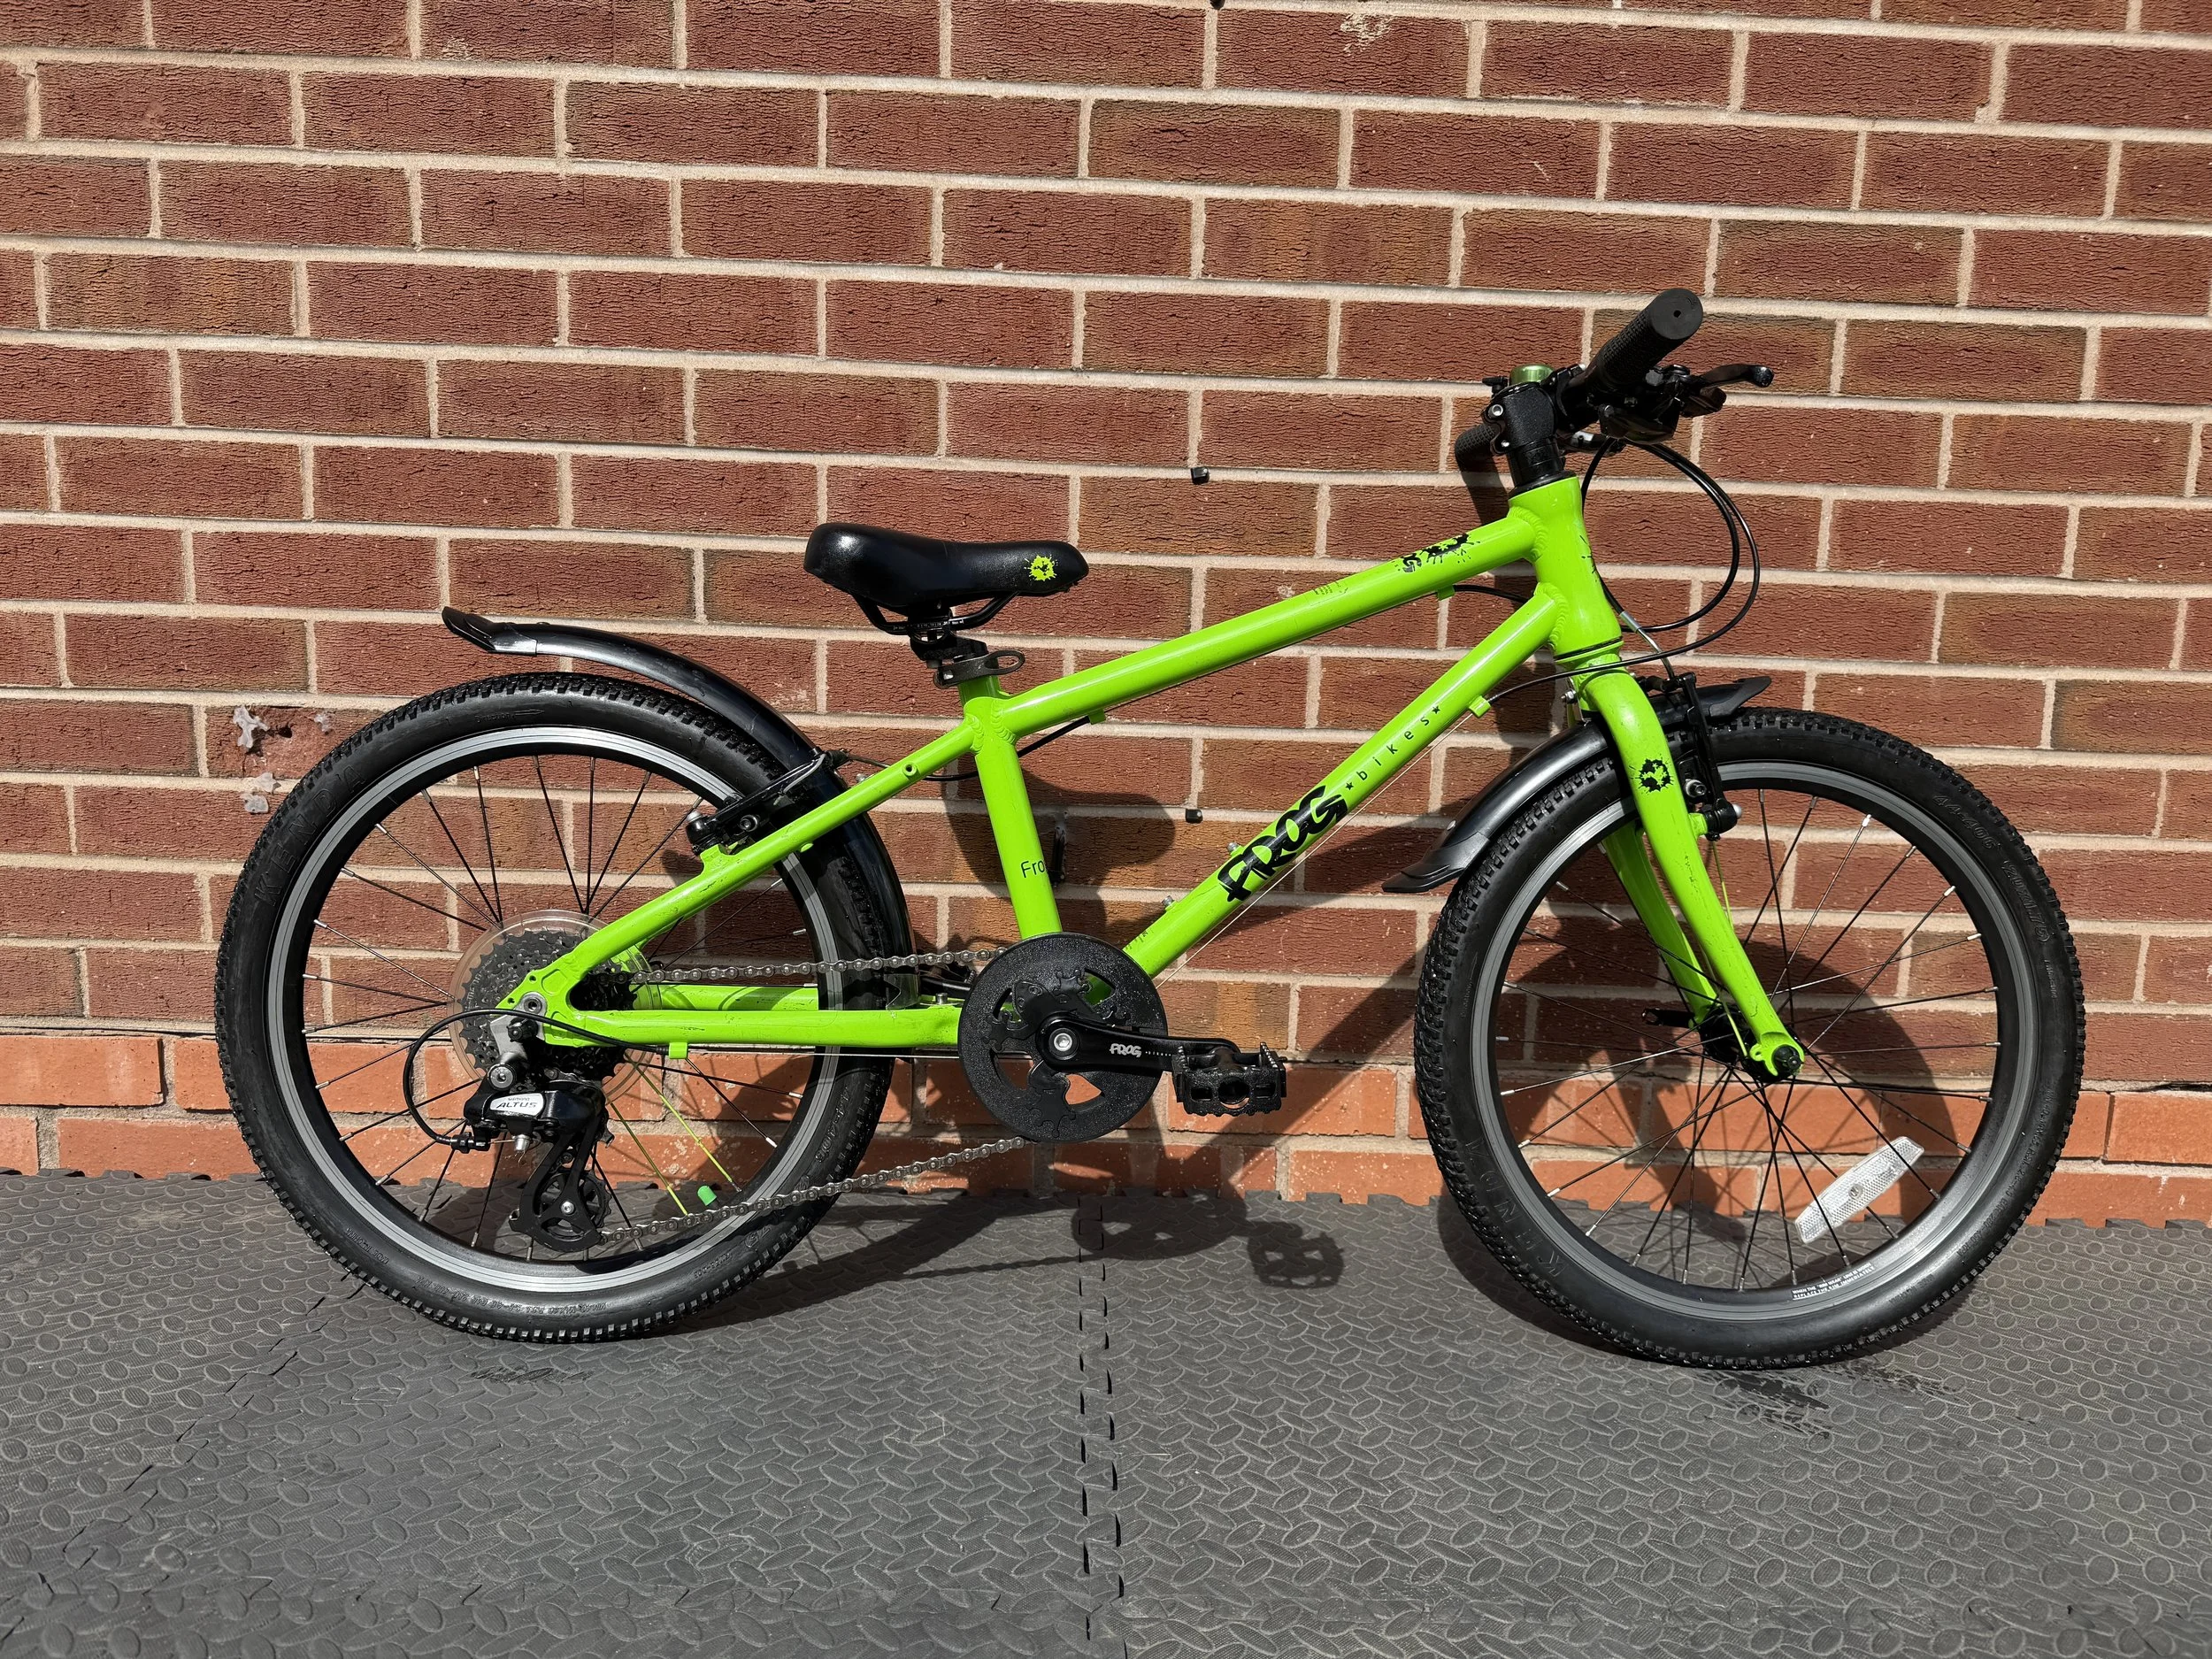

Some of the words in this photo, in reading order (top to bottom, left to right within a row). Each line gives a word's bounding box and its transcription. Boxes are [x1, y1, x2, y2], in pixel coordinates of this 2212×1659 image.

[1356, 717, 1430, 780] bikes
[255, 764, 367, 907] KENDA
[1217, 786, 1348, 902] FROG
[1021, 861, 1045, 878] Fro
[1110, 1043, 1141, 1057] FROG
